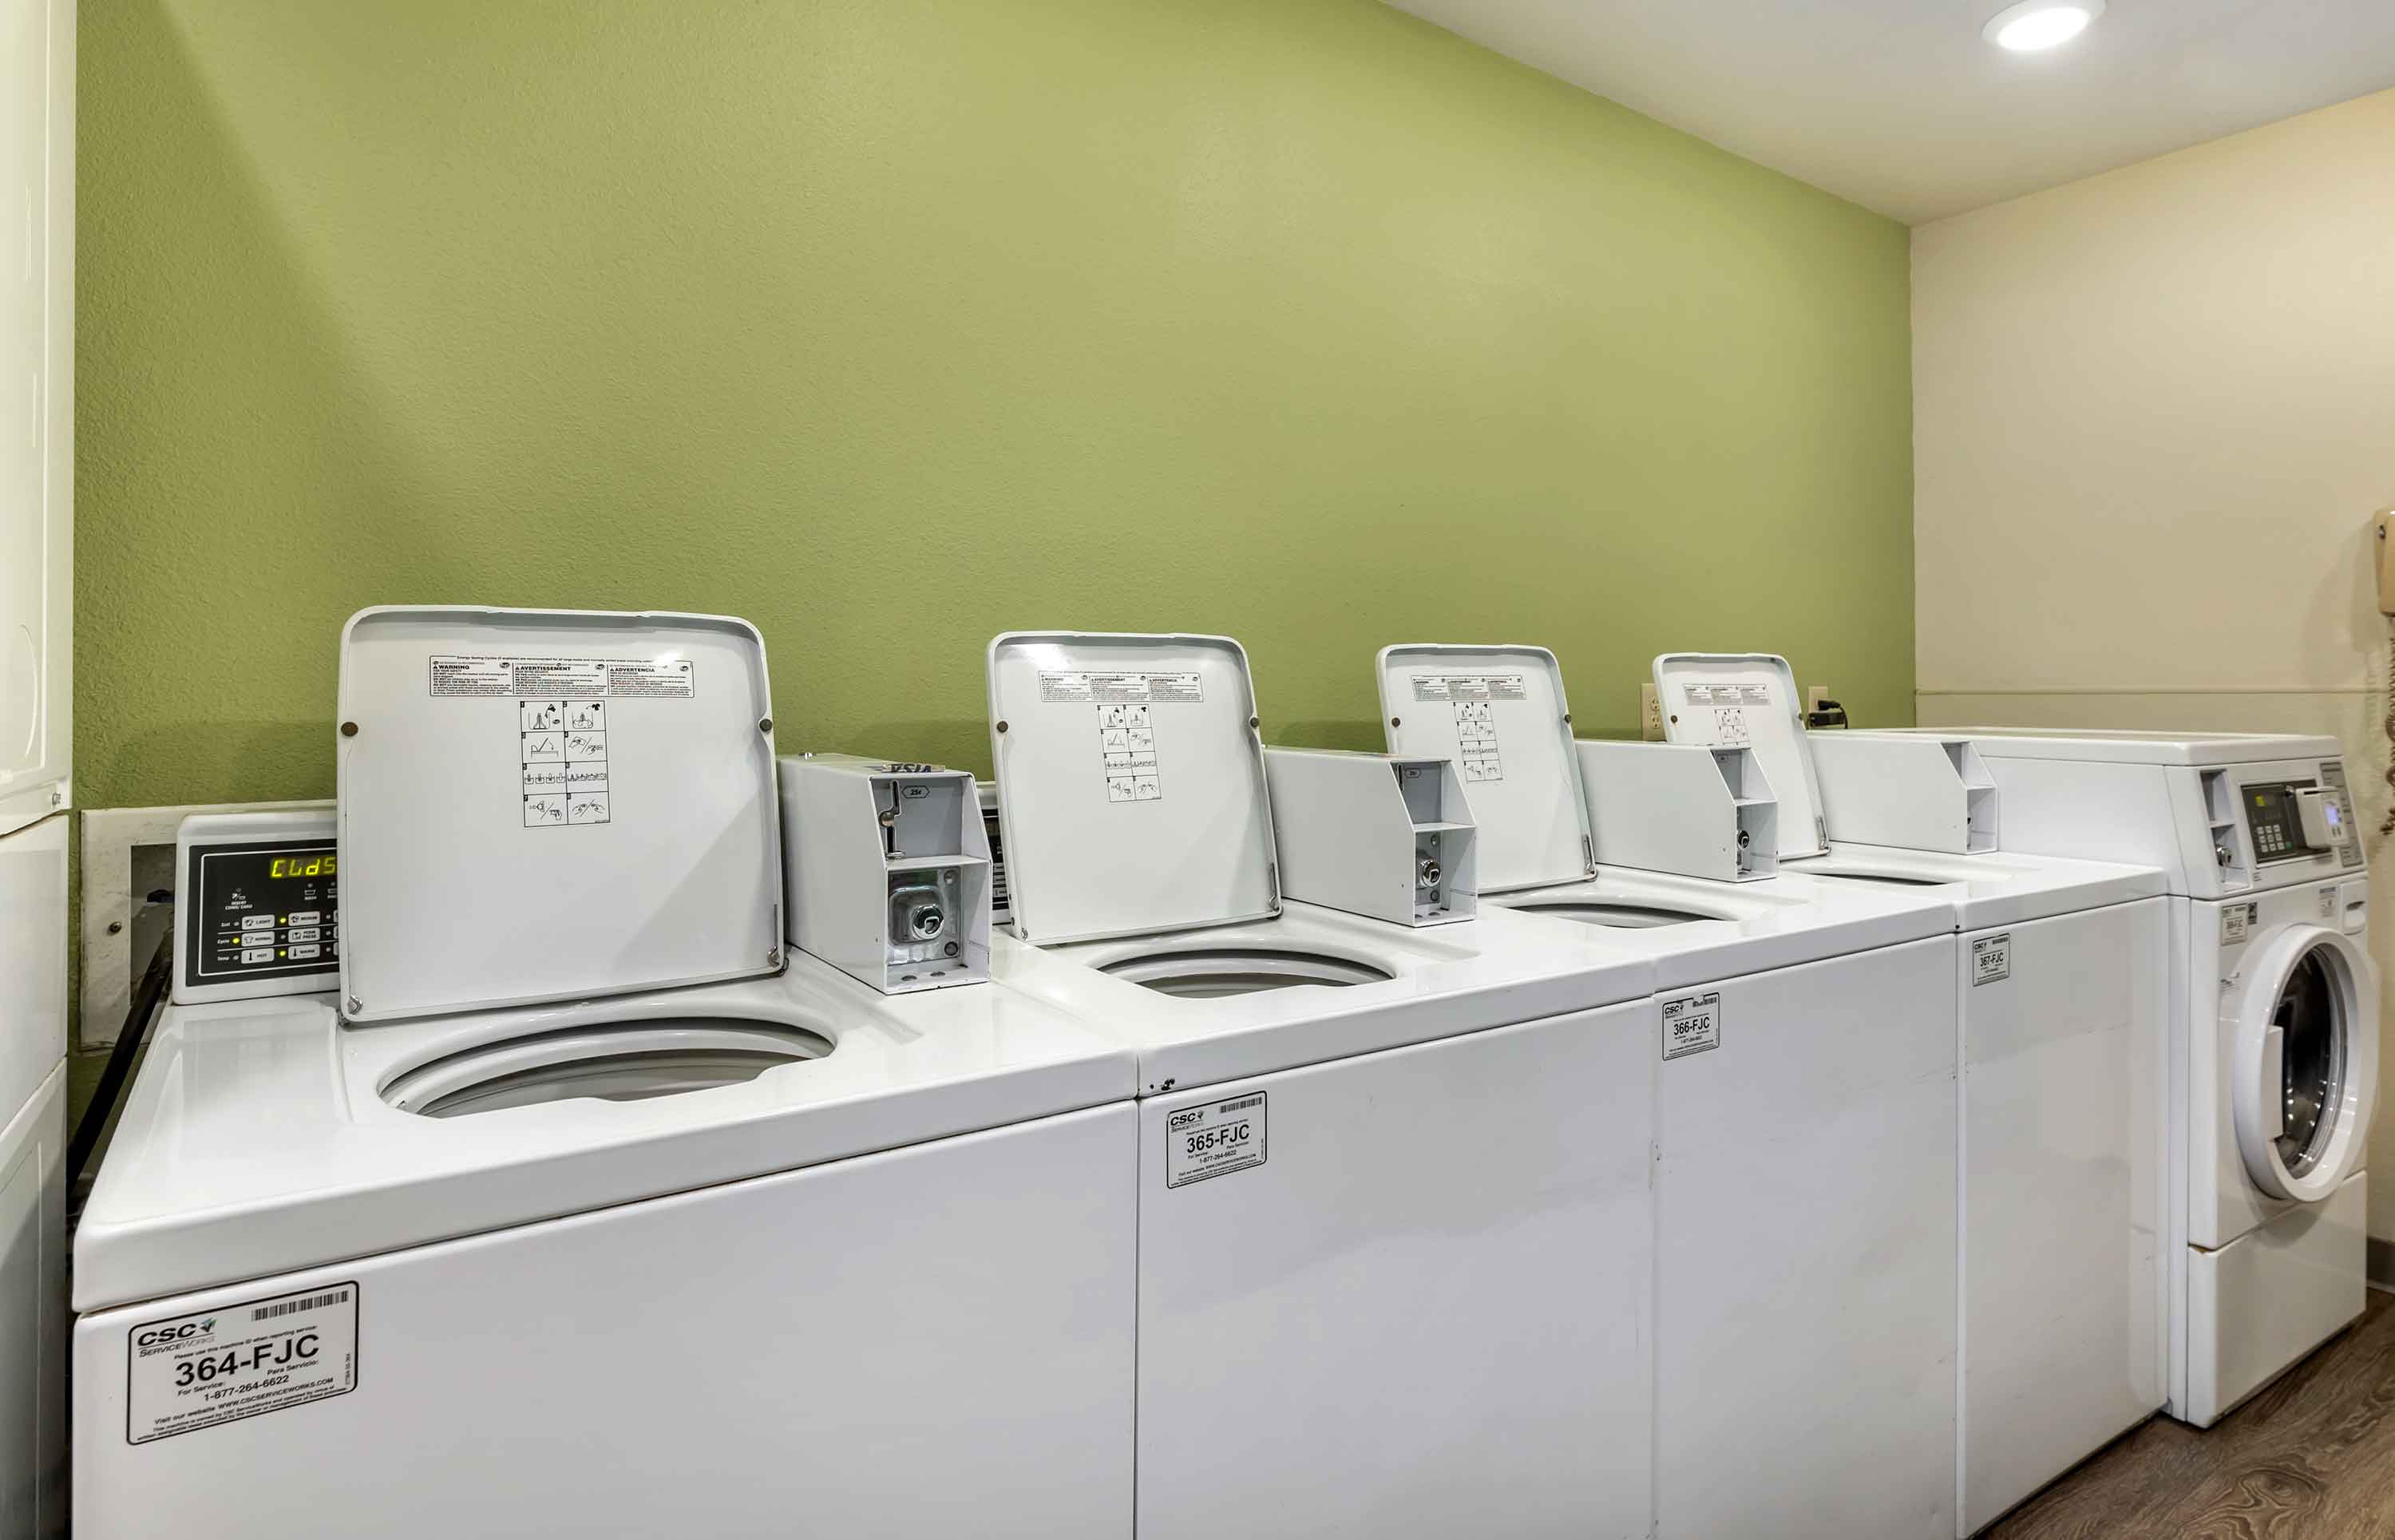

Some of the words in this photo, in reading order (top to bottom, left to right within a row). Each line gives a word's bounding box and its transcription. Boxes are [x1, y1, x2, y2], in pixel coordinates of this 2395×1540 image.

[1665, 1005, 1680, 1014] CSC
[1673, 1016, 1710, 1035] 366-FJC
[1170, 1112, 1196, 1126] CSC
[1187, 1124, 1249, 1153] 365-FJC
[137, 1324, 196, 1346] CSC
[175, 1334, 319, 1386] 364-FJC
[267, 1366, 283, 1375] Para
[178, 1388, 192, 1396] For
[204, 1375, 289, 1401] 1-877-264-6622
[154, 1415, 170, 1424] Visit
